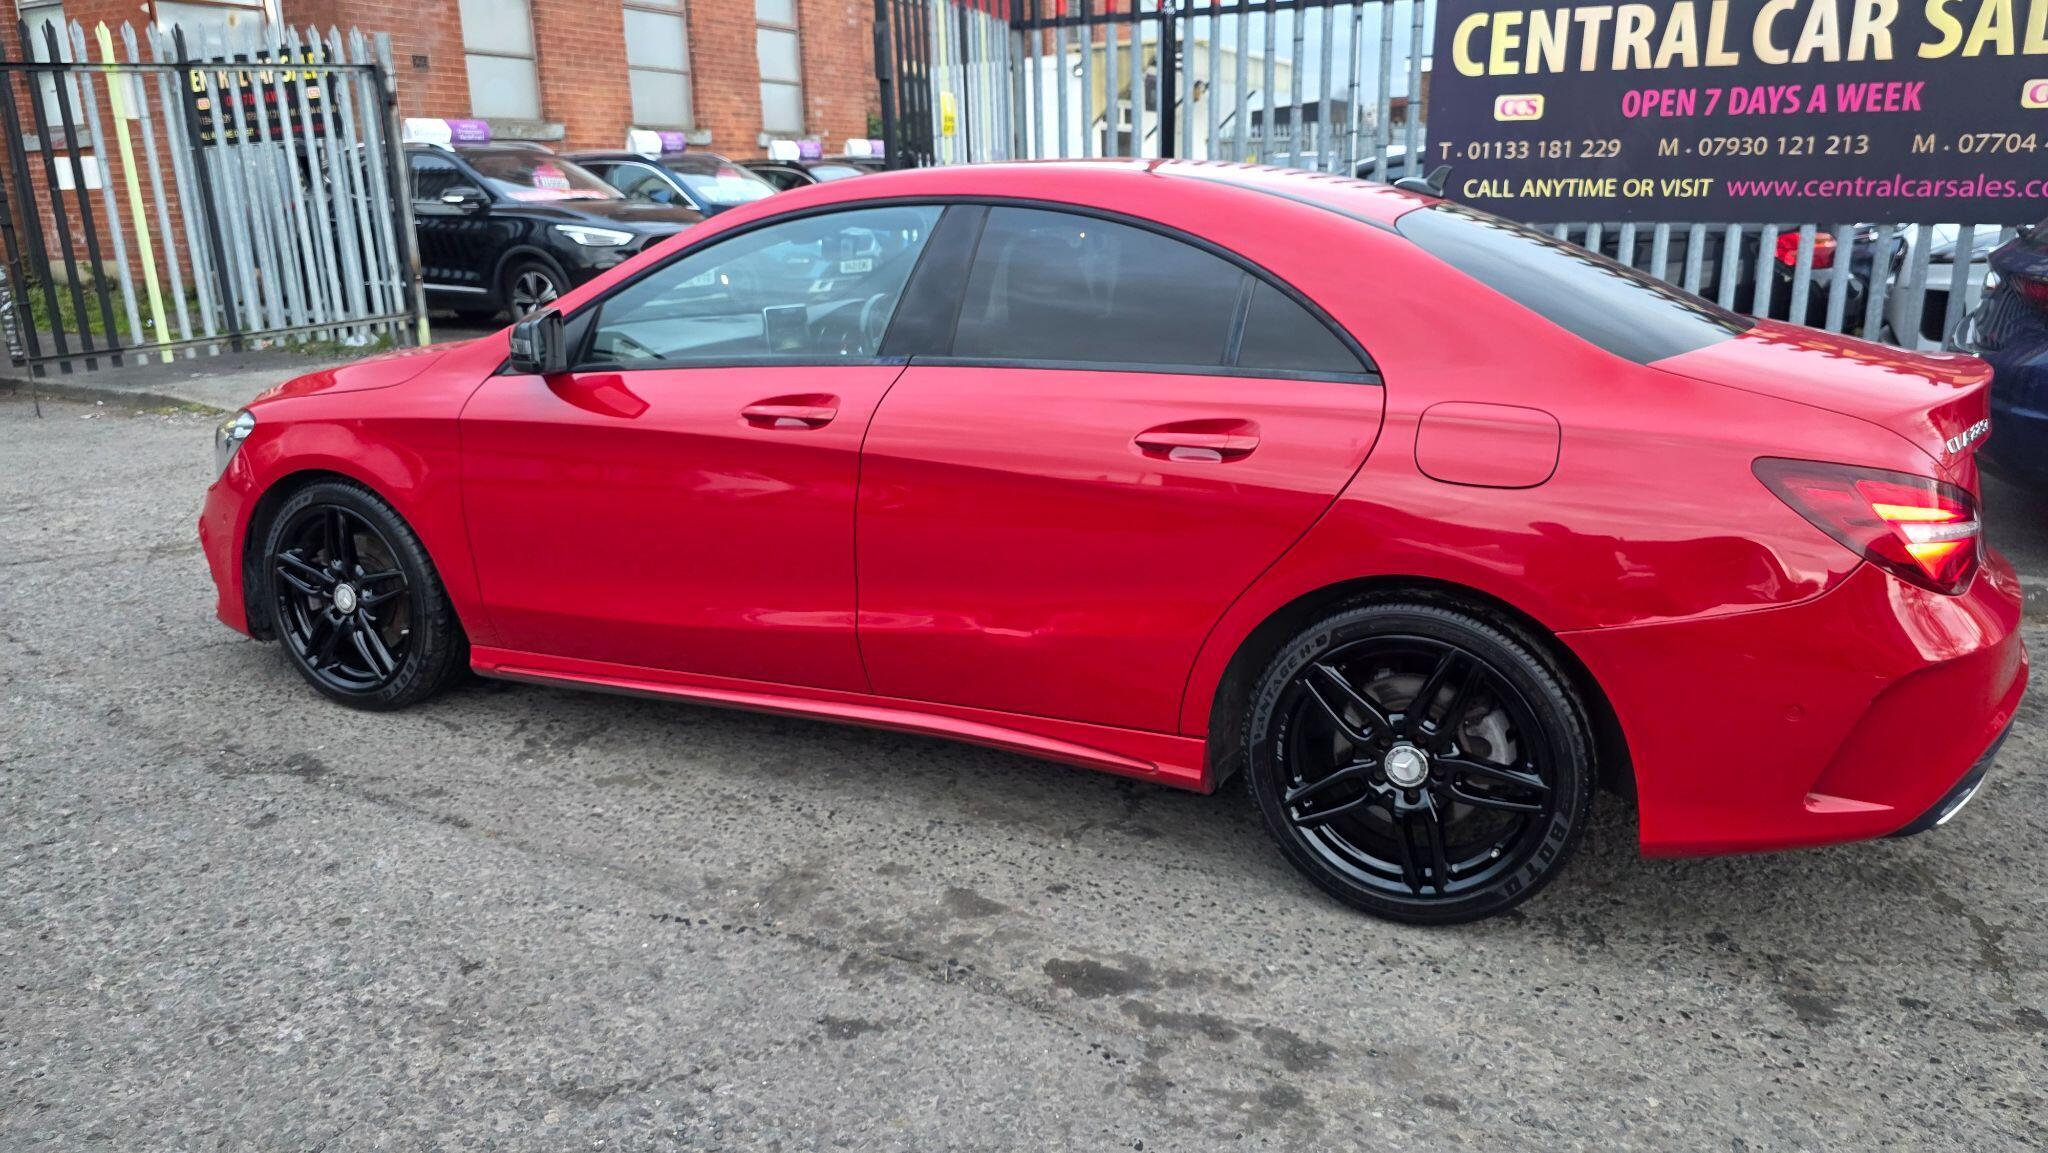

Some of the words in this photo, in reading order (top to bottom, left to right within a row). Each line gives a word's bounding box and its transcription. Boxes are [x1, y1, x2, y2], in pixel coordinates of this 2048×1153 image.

[1452, 0, 1740, 77] CENTRAL
[1752, 0, 1899, 65] CAR
[1500, 99, 1538, 117] CCS
[1621, 89, 1697, 118] OPEN
[1704, 88, 1722, 116] 7
[1728, 85, 1802, 115] DAYS
[1806, 83, 1827, 114] A
[1836, 81, 1926, 113] WEEK
[1467, 140, 1529, 160] 01133
[1538, 139, 1572, 159] 181
[1579, 138, 1622, 158] 229
[1698, 135, 1768, 156] 07930
[1776, 135, 1815, 156] 121
[1824, 134, 1870, 155] 213
[1957, 132, 2037, 154] 07704
[1463, 178, 1515, 199] CALL
[1519, 178, 1617, 198] ANYTIME
[1622, 178, 1654, 198] OR
[1660, 177, 1714, 197] VISIT
